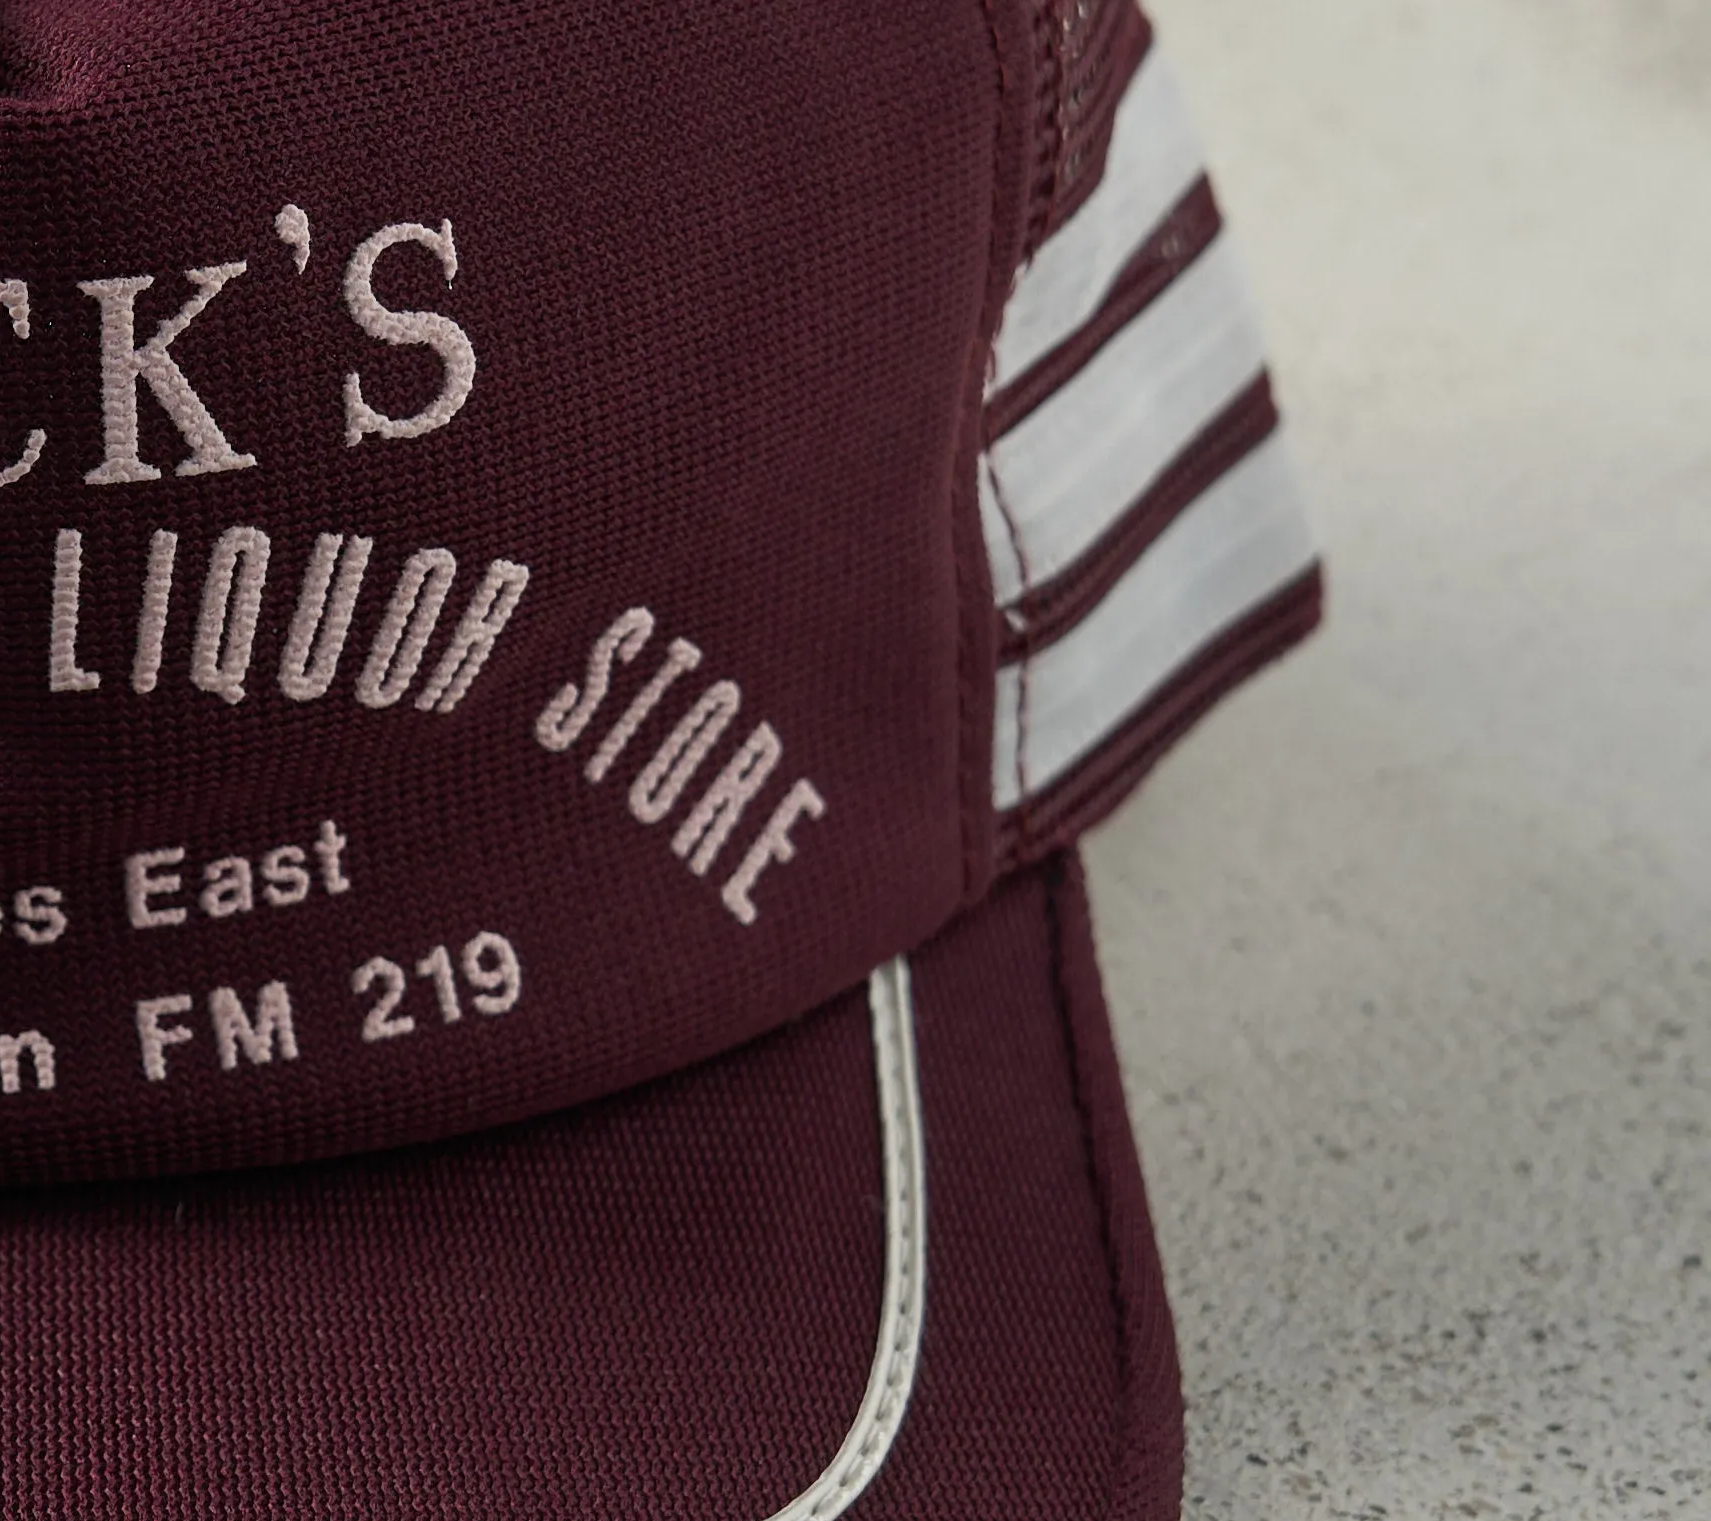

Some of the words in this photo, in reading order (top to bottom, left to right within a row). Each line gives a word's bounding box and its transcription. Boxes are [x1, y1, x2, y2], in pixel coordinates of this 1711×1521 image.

[49, 525, 530, 713] LIQUOR
[536, 606, 825, 925] STORE
[130, 819, 351, 926] East
[137, 980, 298, 1080] FM
[355, 930, 521, 1040] 219
